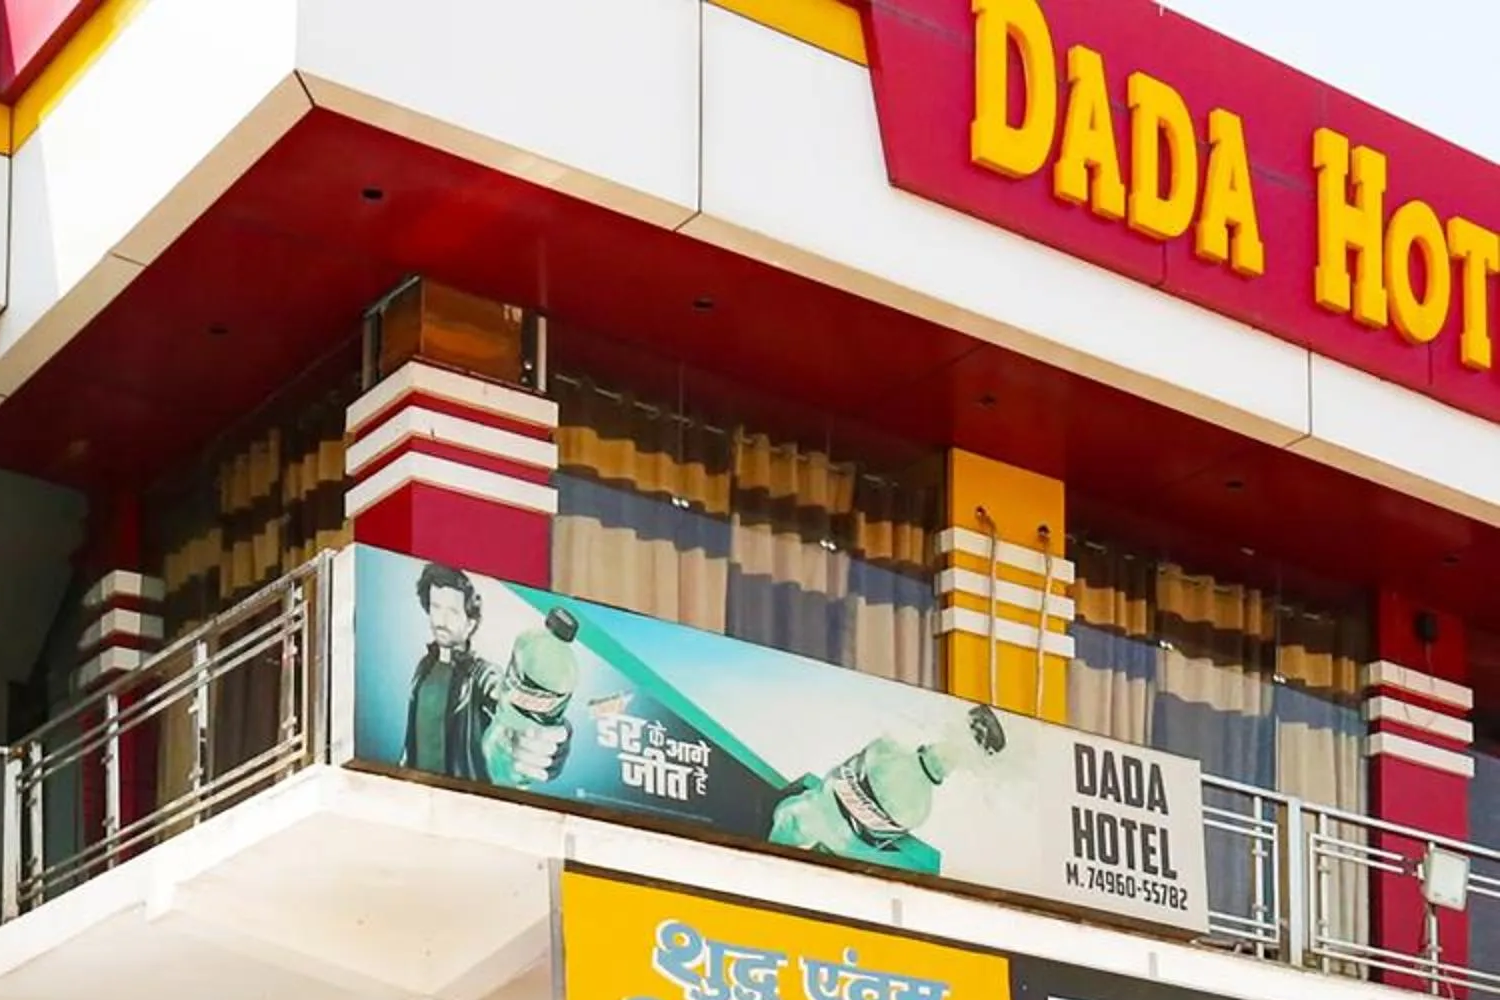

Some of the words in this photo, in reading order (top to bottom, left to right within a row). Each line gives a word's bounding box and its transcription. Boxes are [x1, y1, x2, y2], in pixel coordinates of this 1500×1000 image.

[970, 0, 1265, 278] DADA
[646, 720, 668, 747] के
[618, 747, 694, 801] जीत
[1074, 742, 1169, 816] DADA
[1071, 805, 1178, 881] HOTEL
